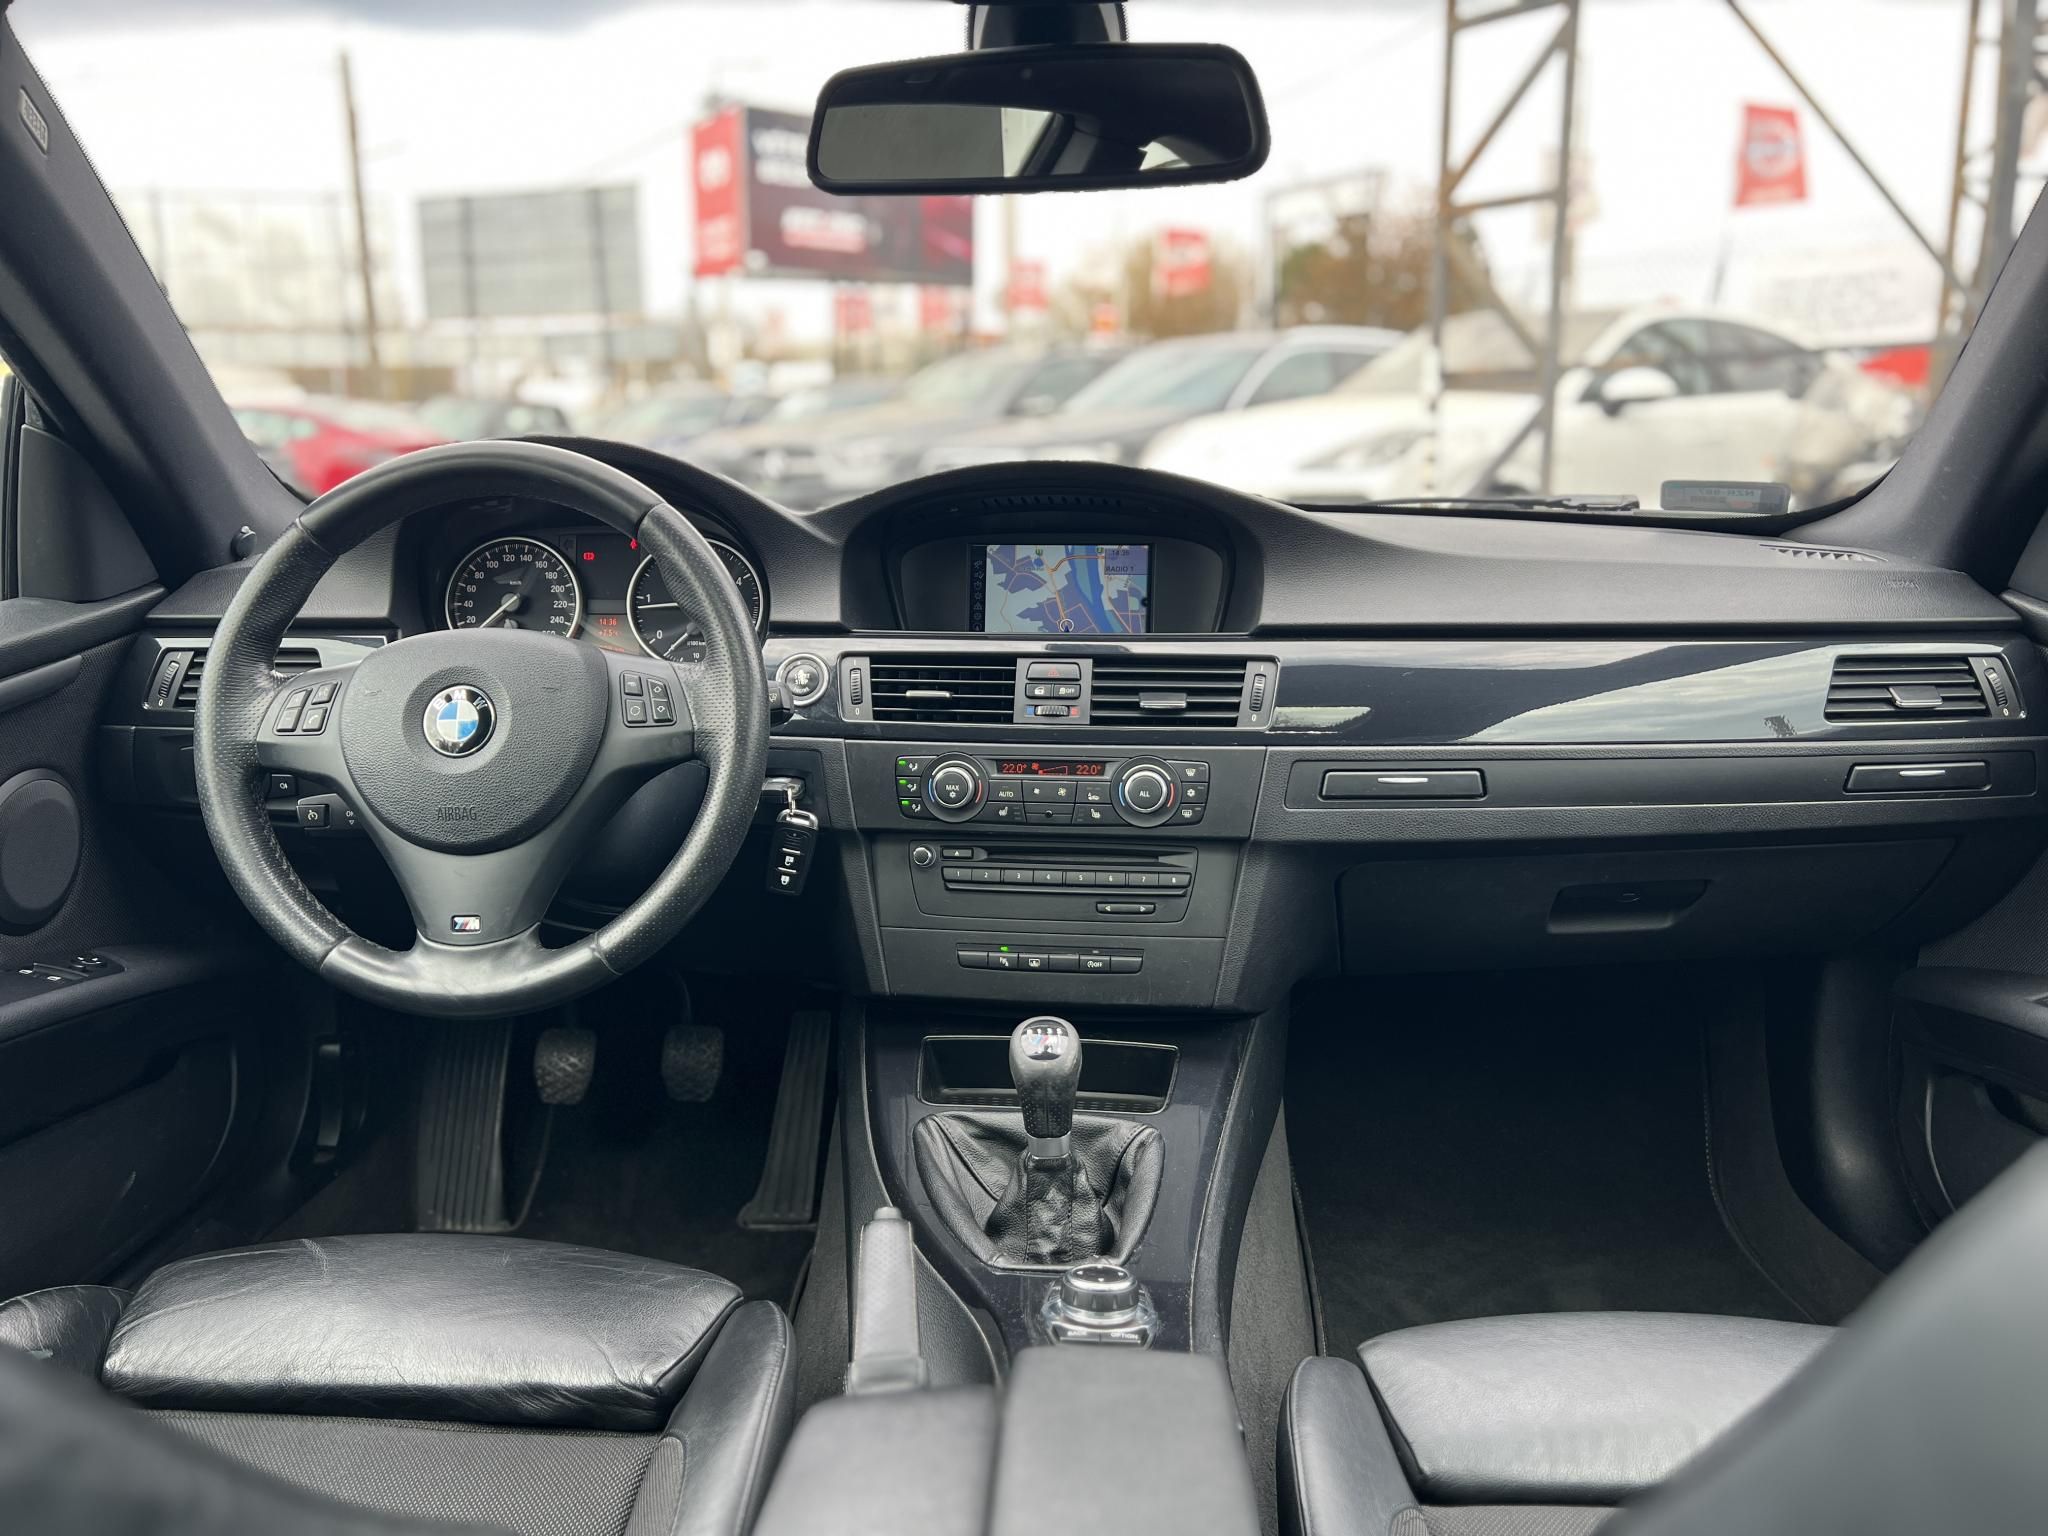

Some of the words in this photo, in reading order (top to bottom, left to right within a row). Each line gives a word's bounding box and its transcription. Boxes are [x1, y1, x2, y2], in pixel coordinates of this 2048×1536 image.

[502, 554, 515, 562] 120
[519, 554, 533, 562] 140
[486, 560, 499, 568] 100
[535, 560, 548, 568] 160
[474, 571, 484, 579] 80
[544, 571, 558, 579] 180
[466, 584, 477, 593] 60
[550, 585, 565, 593] 200
[463, 600, 474, 608] 40
[553, 600, 568, 608] 220
[465, 615, 476, 624] 20
[549, 615, 565, 624] 240
[432, 688, 488, 710] BMW
[437, 806, 478, 822] AIRBAG
